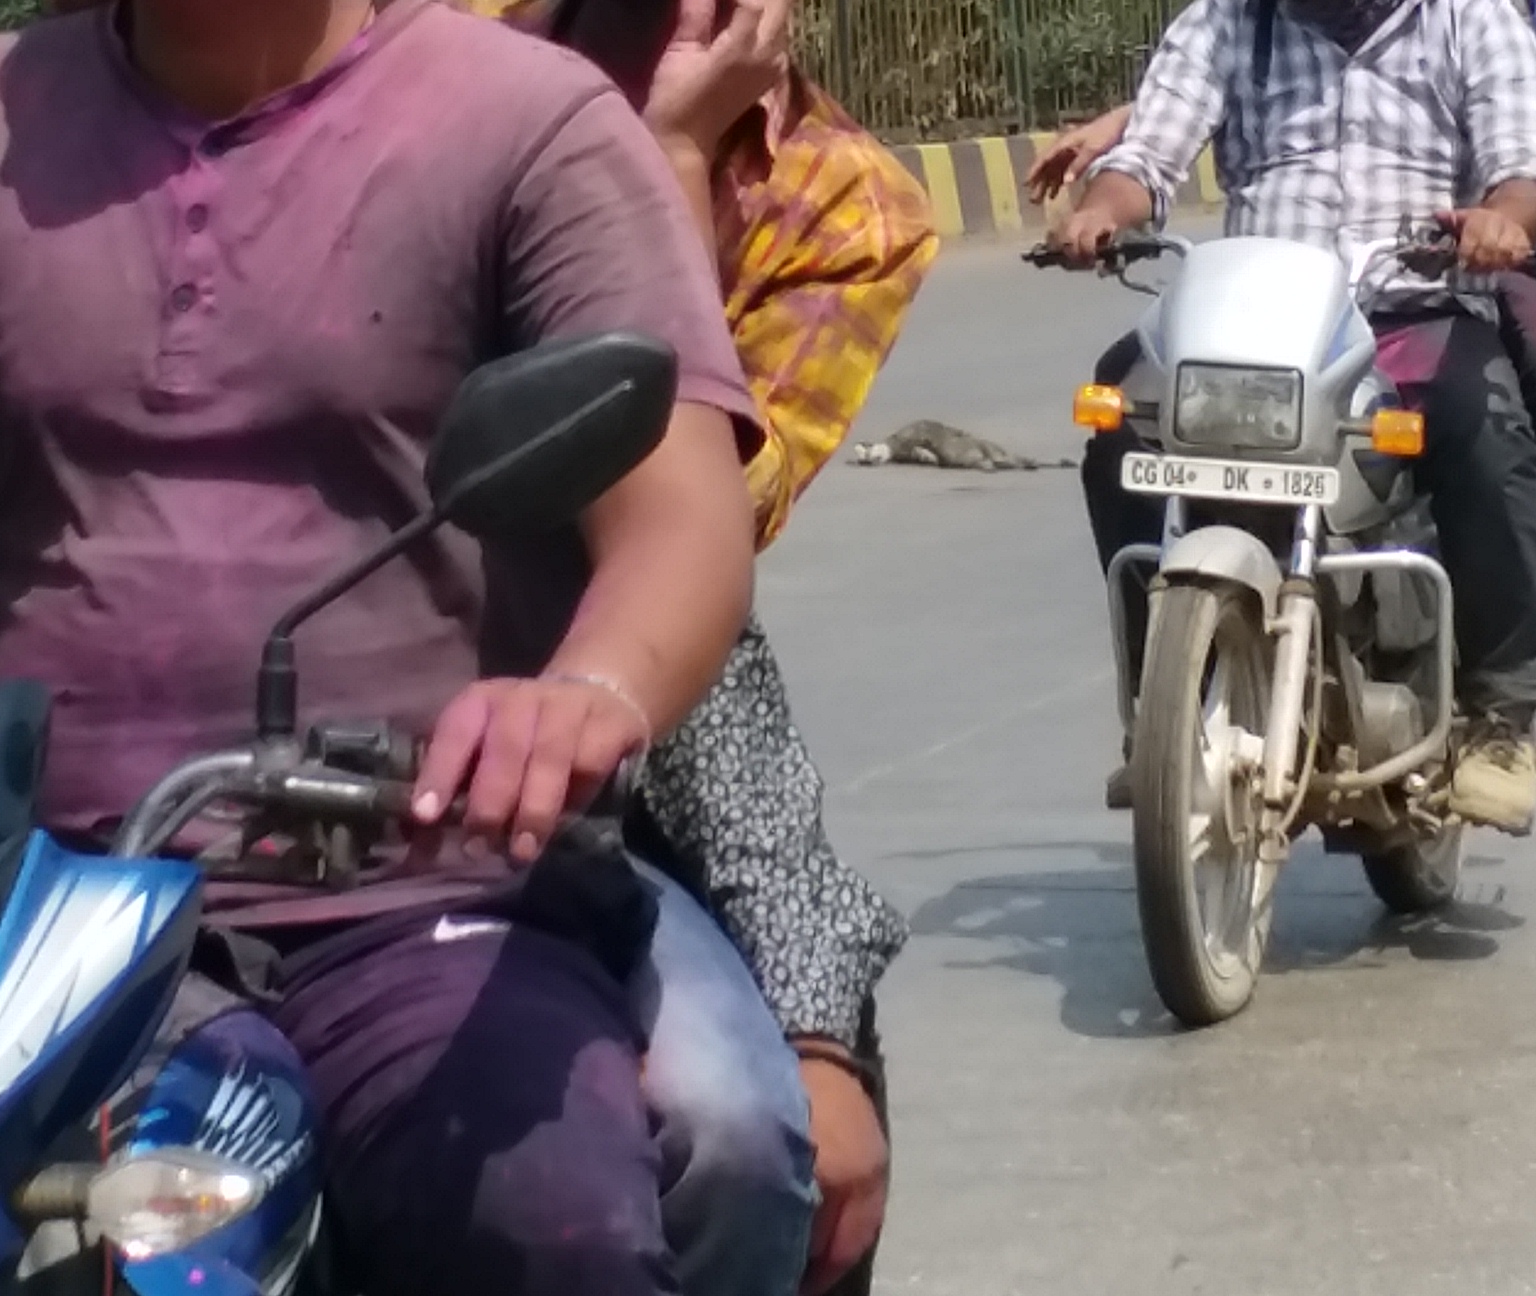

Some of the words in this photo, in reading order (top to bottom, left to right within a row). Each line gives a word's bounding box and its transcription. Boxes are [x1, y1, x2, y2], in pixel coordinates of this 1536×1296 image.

[1131, 460, 1157, 484] CG
[1163, 464, 1185, 487] 04
[1223, 467, 1249, 491] DK
